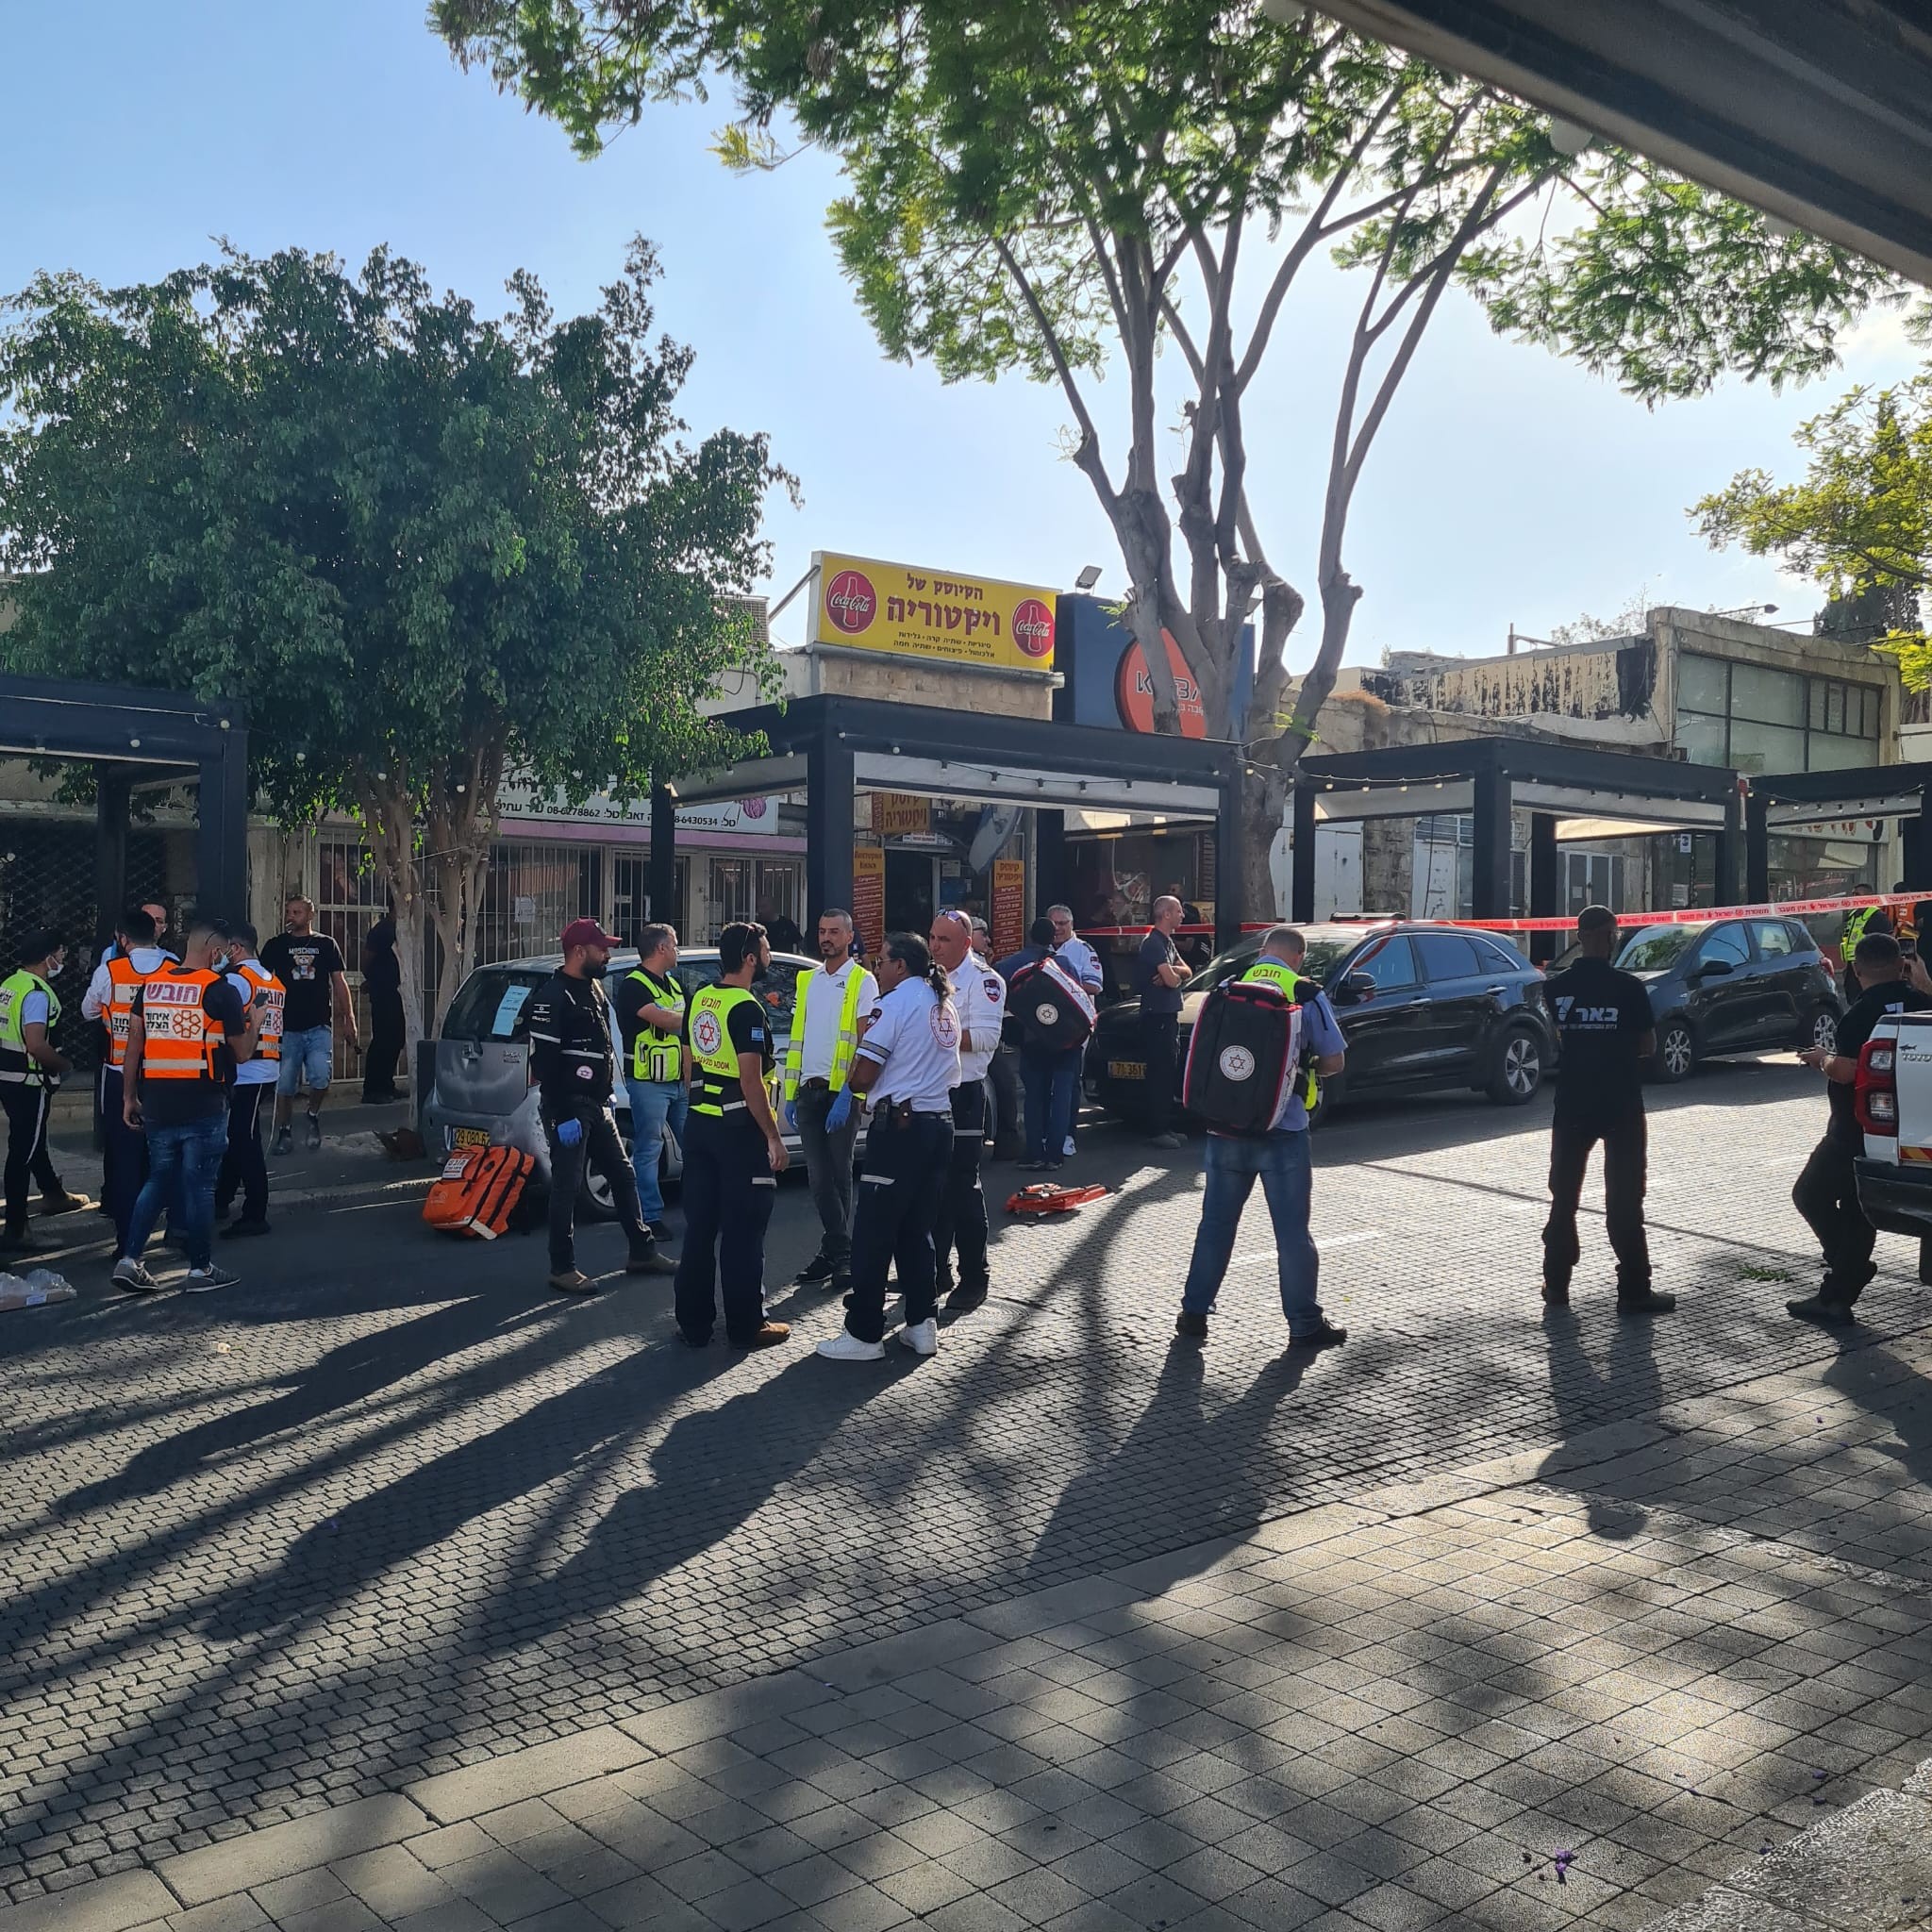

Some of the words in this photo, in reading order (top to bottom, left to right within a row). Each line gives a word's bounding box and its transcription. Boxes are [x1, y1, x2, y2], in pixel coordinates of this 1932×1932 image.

[907, 573, 925, 591] של
[934, 580, 983, 601] הקיוסק
[887, 595, 1000, 636] ויקטוריה
[1253, 968, 1281, 979] חובש
[146, 984, 198, 1003] חובש
[701, 996, 722, 1009] חובש
[1575, 1007, 1619, 1022] באר
